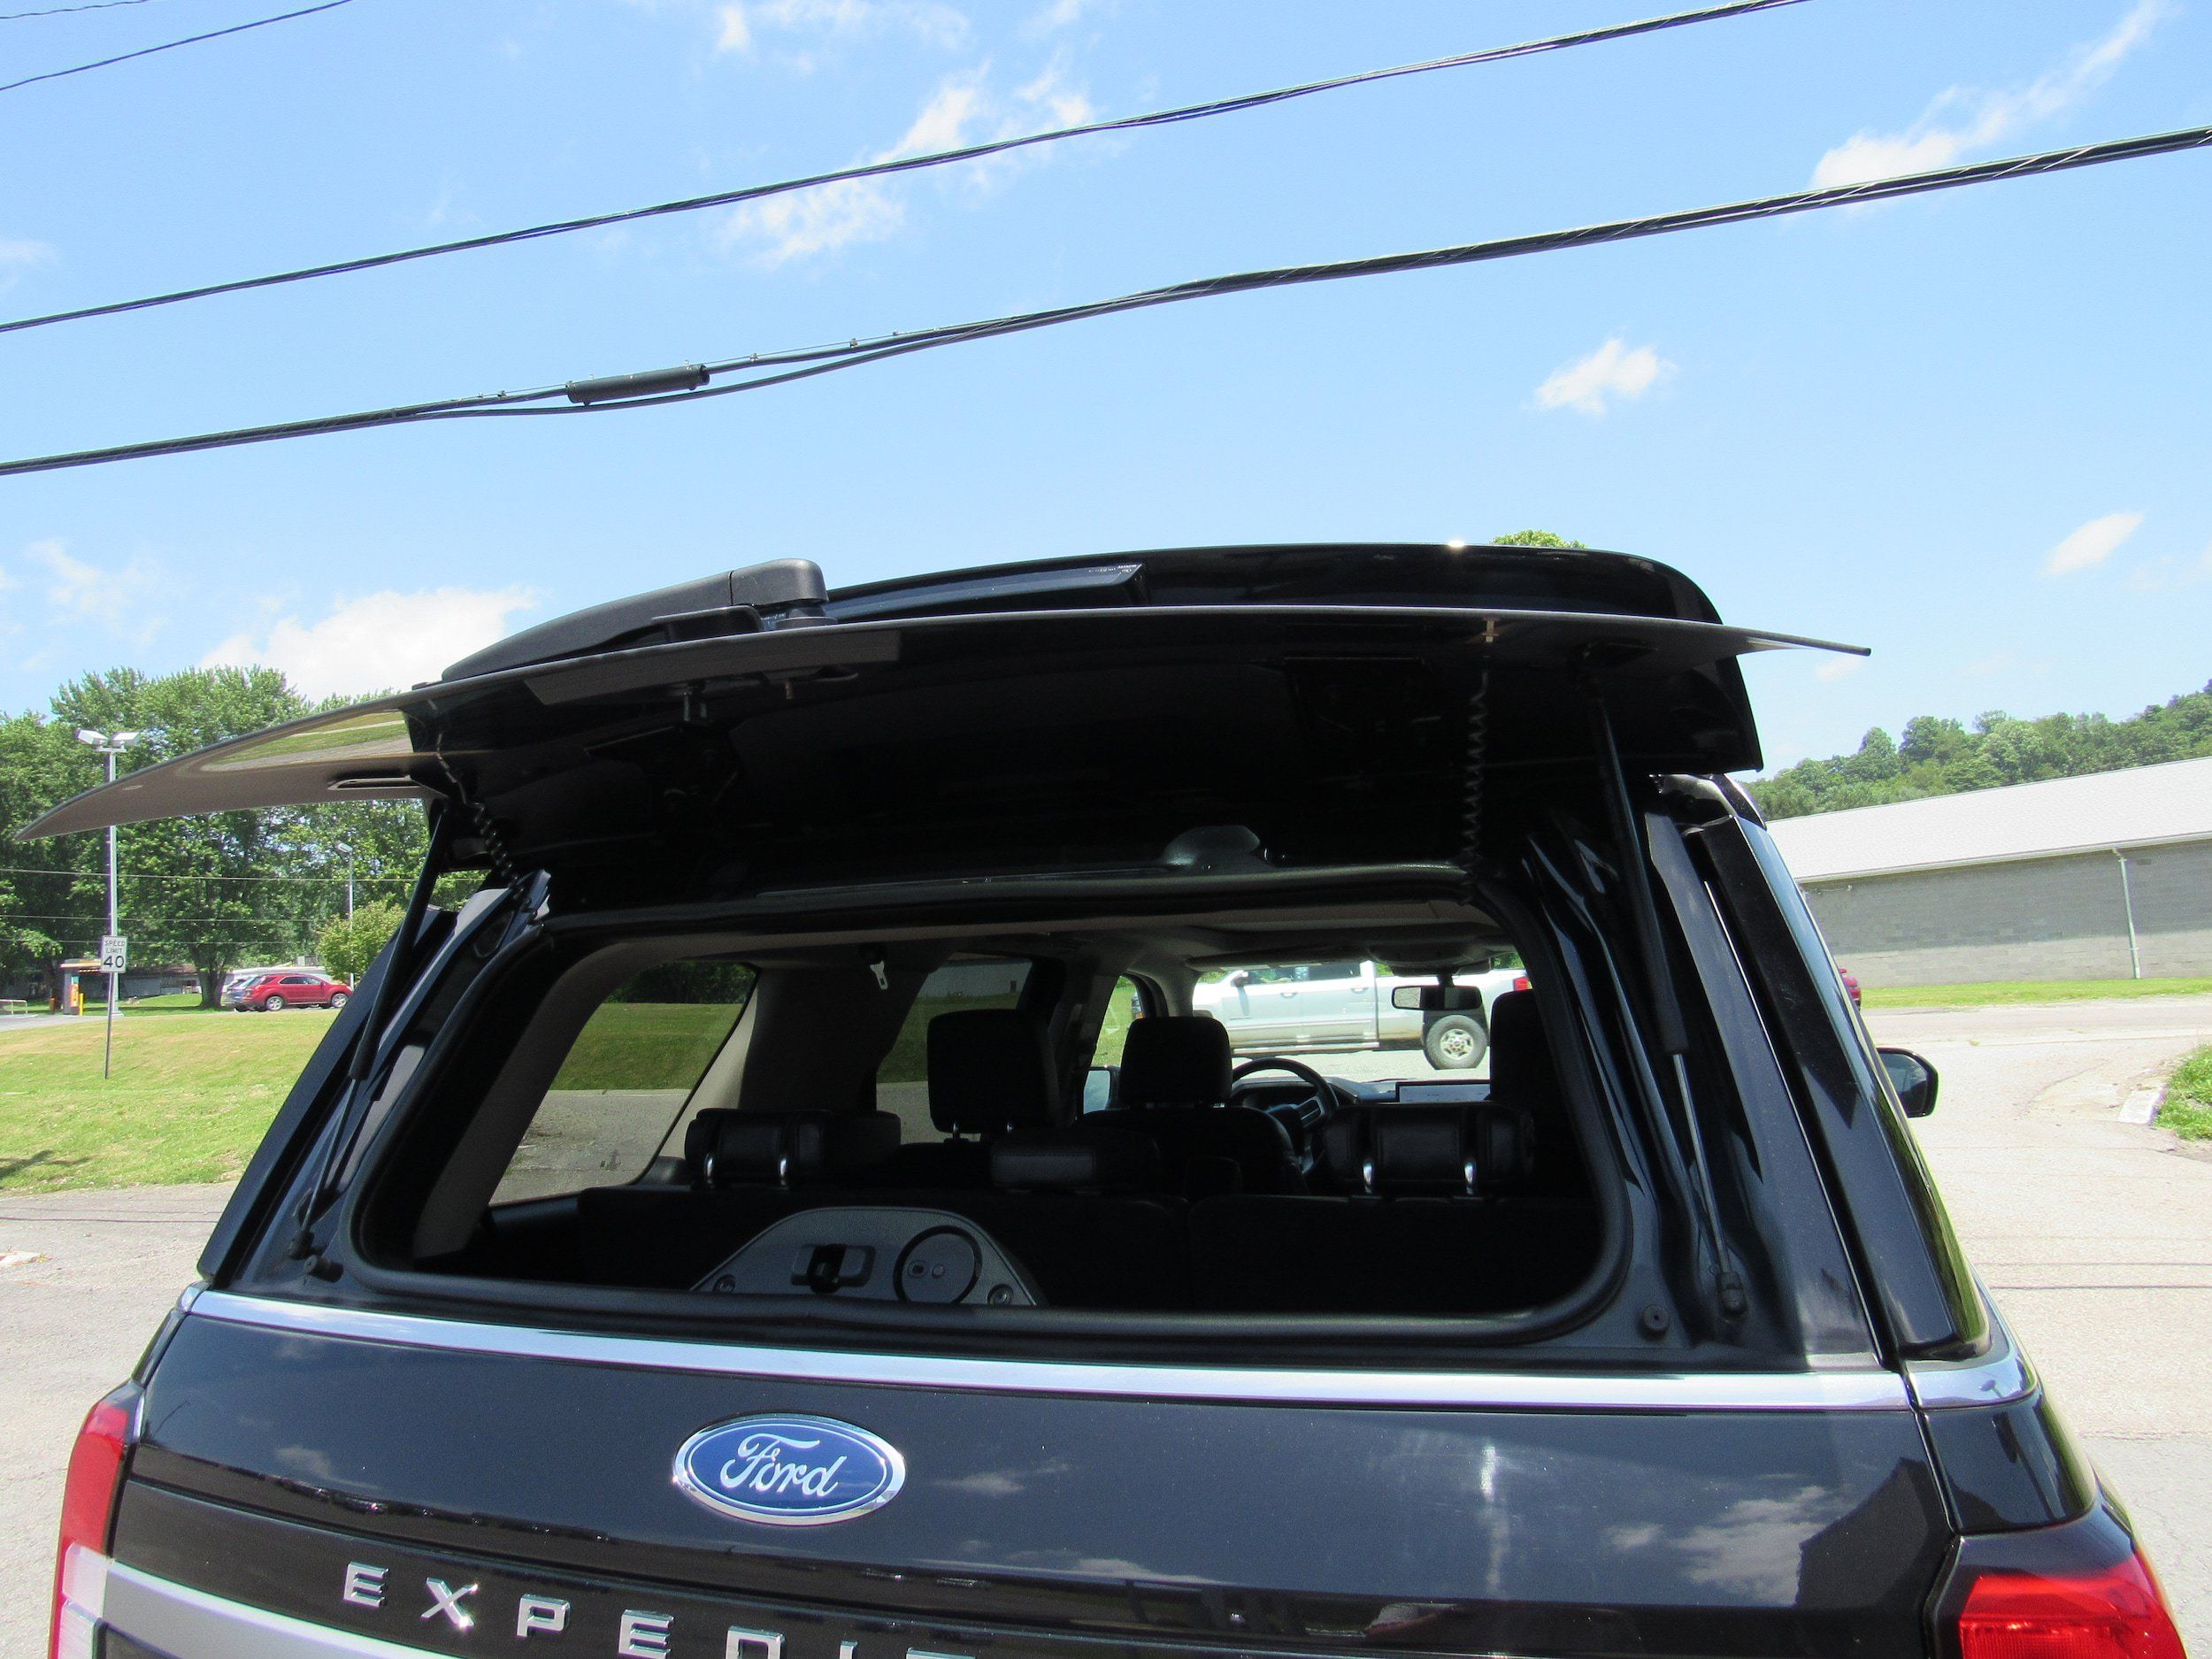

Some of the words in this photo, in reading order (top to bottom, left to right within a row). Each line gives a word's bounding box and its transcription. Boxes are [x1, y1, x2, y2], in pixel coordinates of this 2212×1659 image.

[104, 956, 124, 968] 40
[720, 1432, 847, 1497] Ford
[342, 1561, 976, 1659] EXPED
